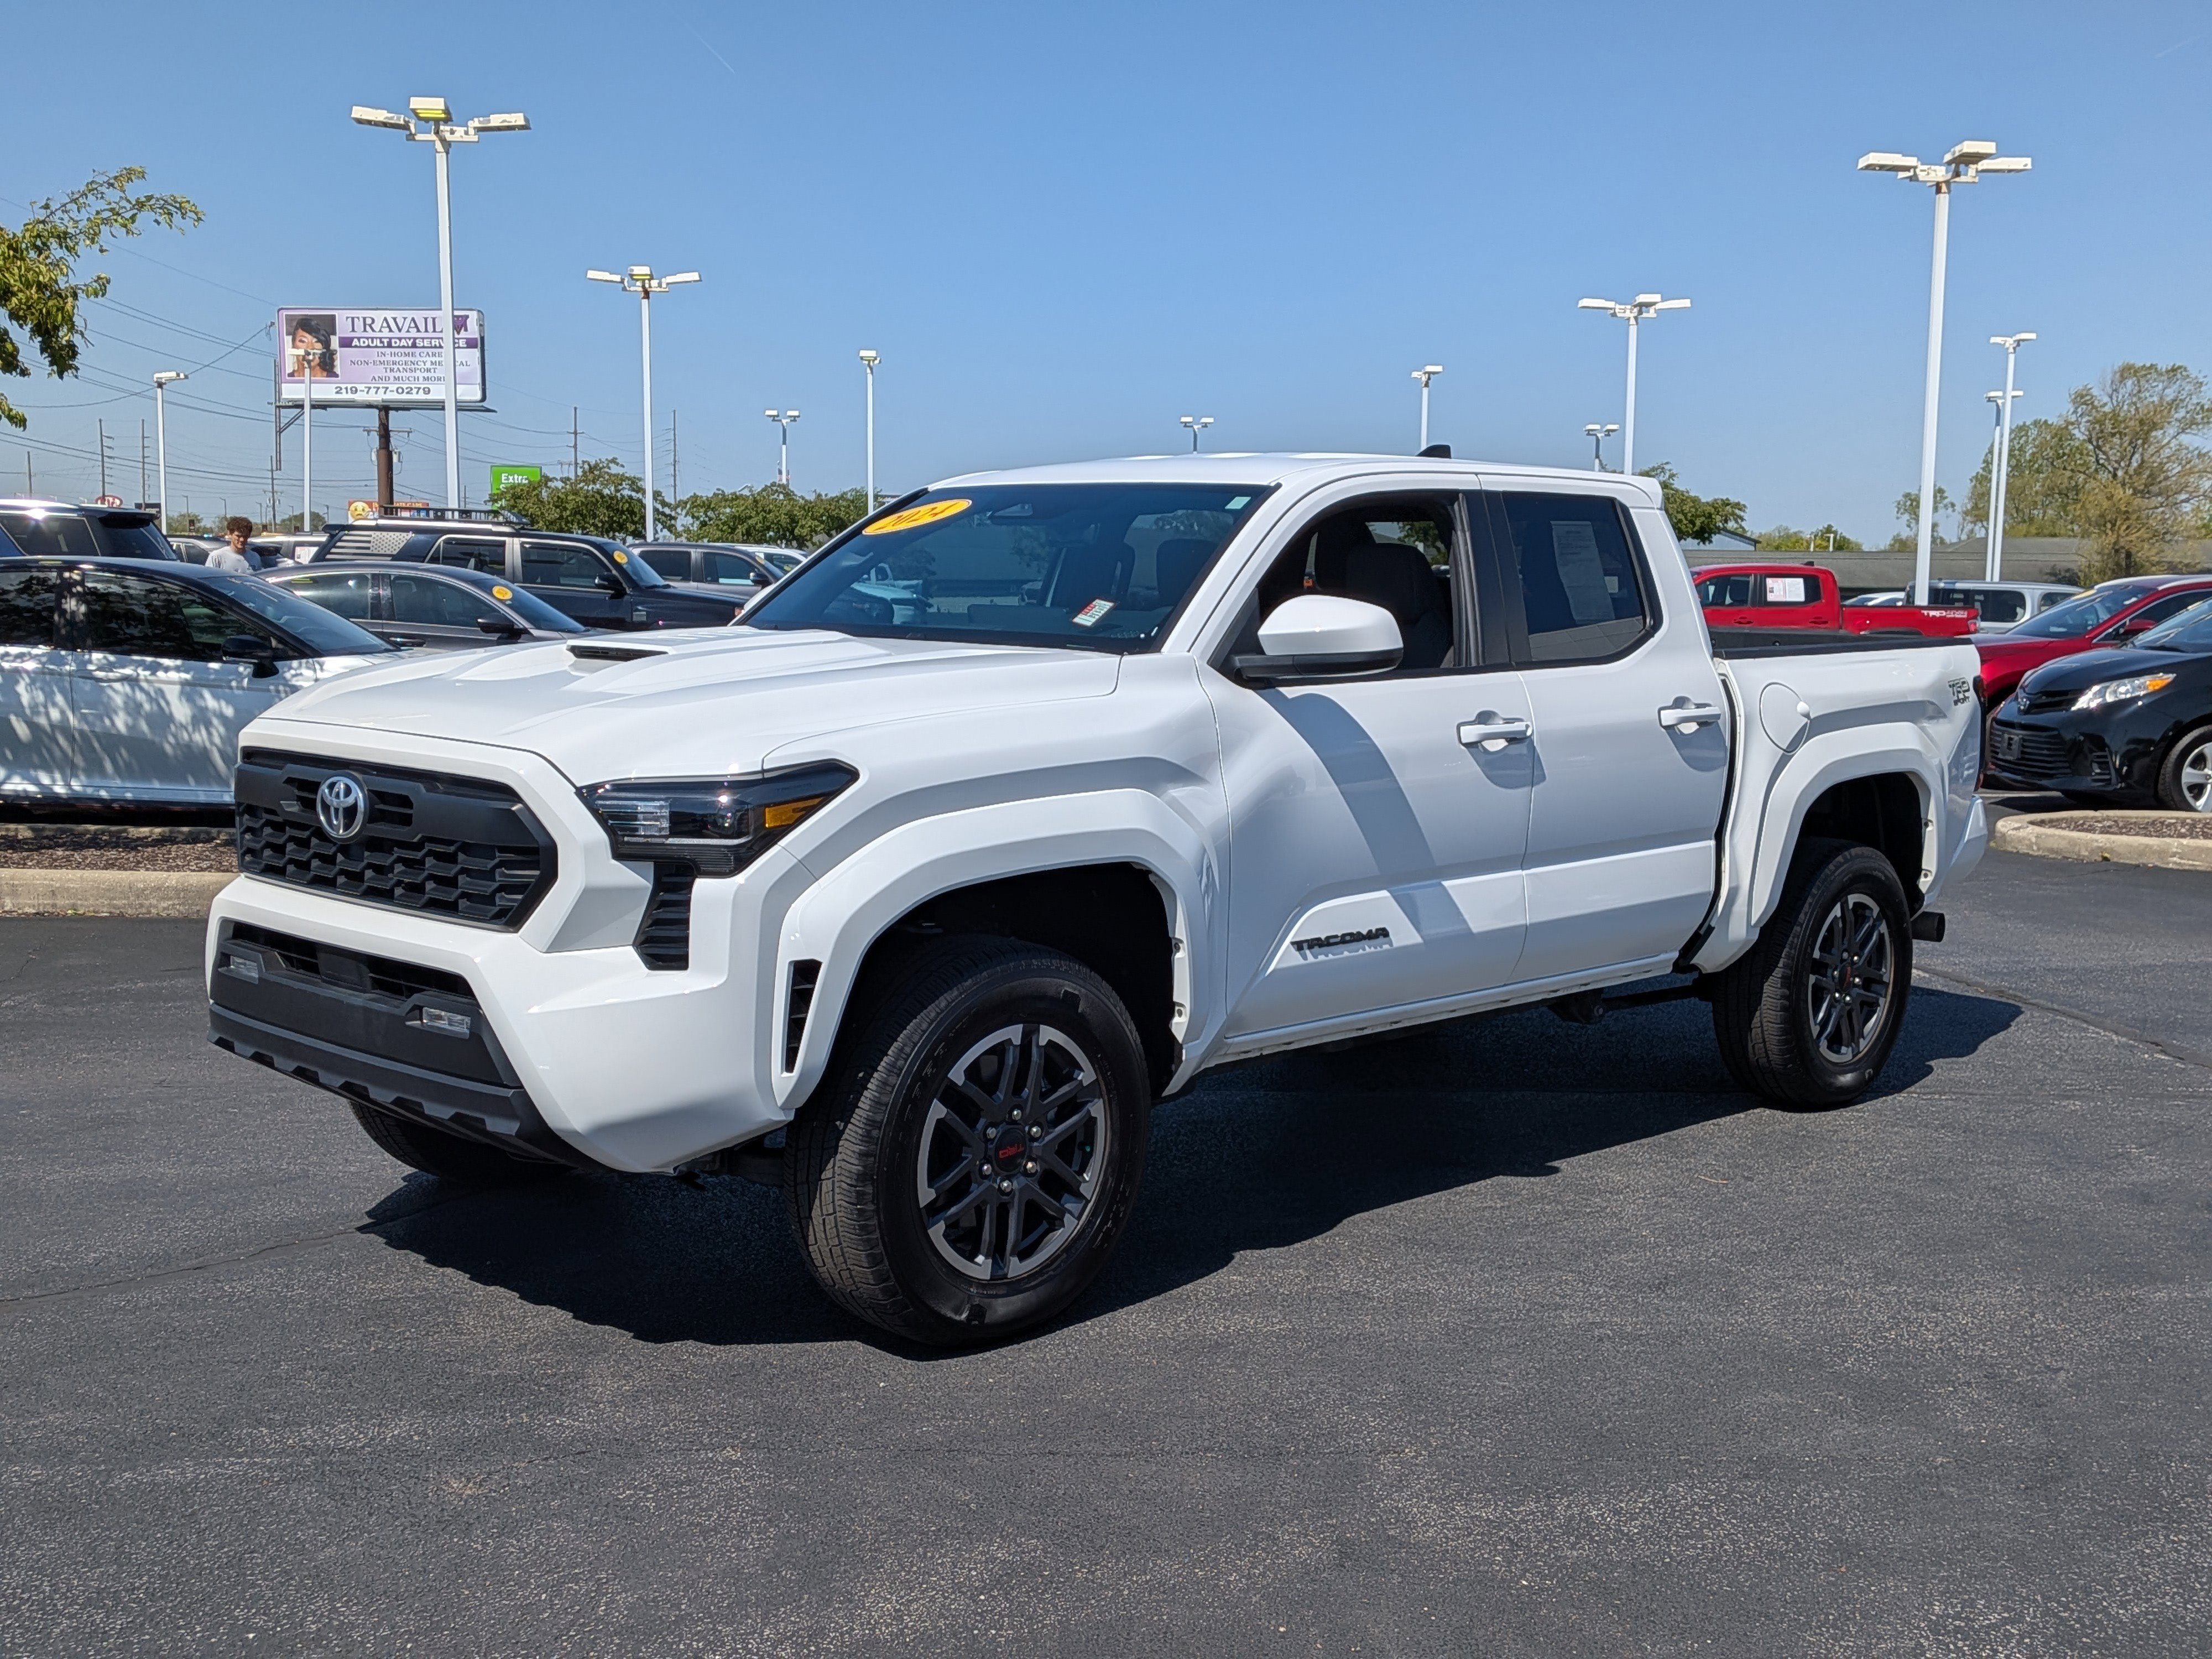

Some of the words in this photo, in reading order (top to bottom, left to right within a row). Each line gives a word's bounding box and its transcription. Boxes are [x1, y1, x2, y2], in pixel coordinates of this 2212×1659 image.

[352, 338, 389, 347] ADULT
[391, 338, 414, 347] DAY
[415, 338, 467, 348] SERVCE
[334, 385, 431, 395] 219-777-0279
[873, 501, 960, 531] 2024
[1948, 677, 1970, 700] TRD
[1290, 926, 1390, 952] TACOMA
